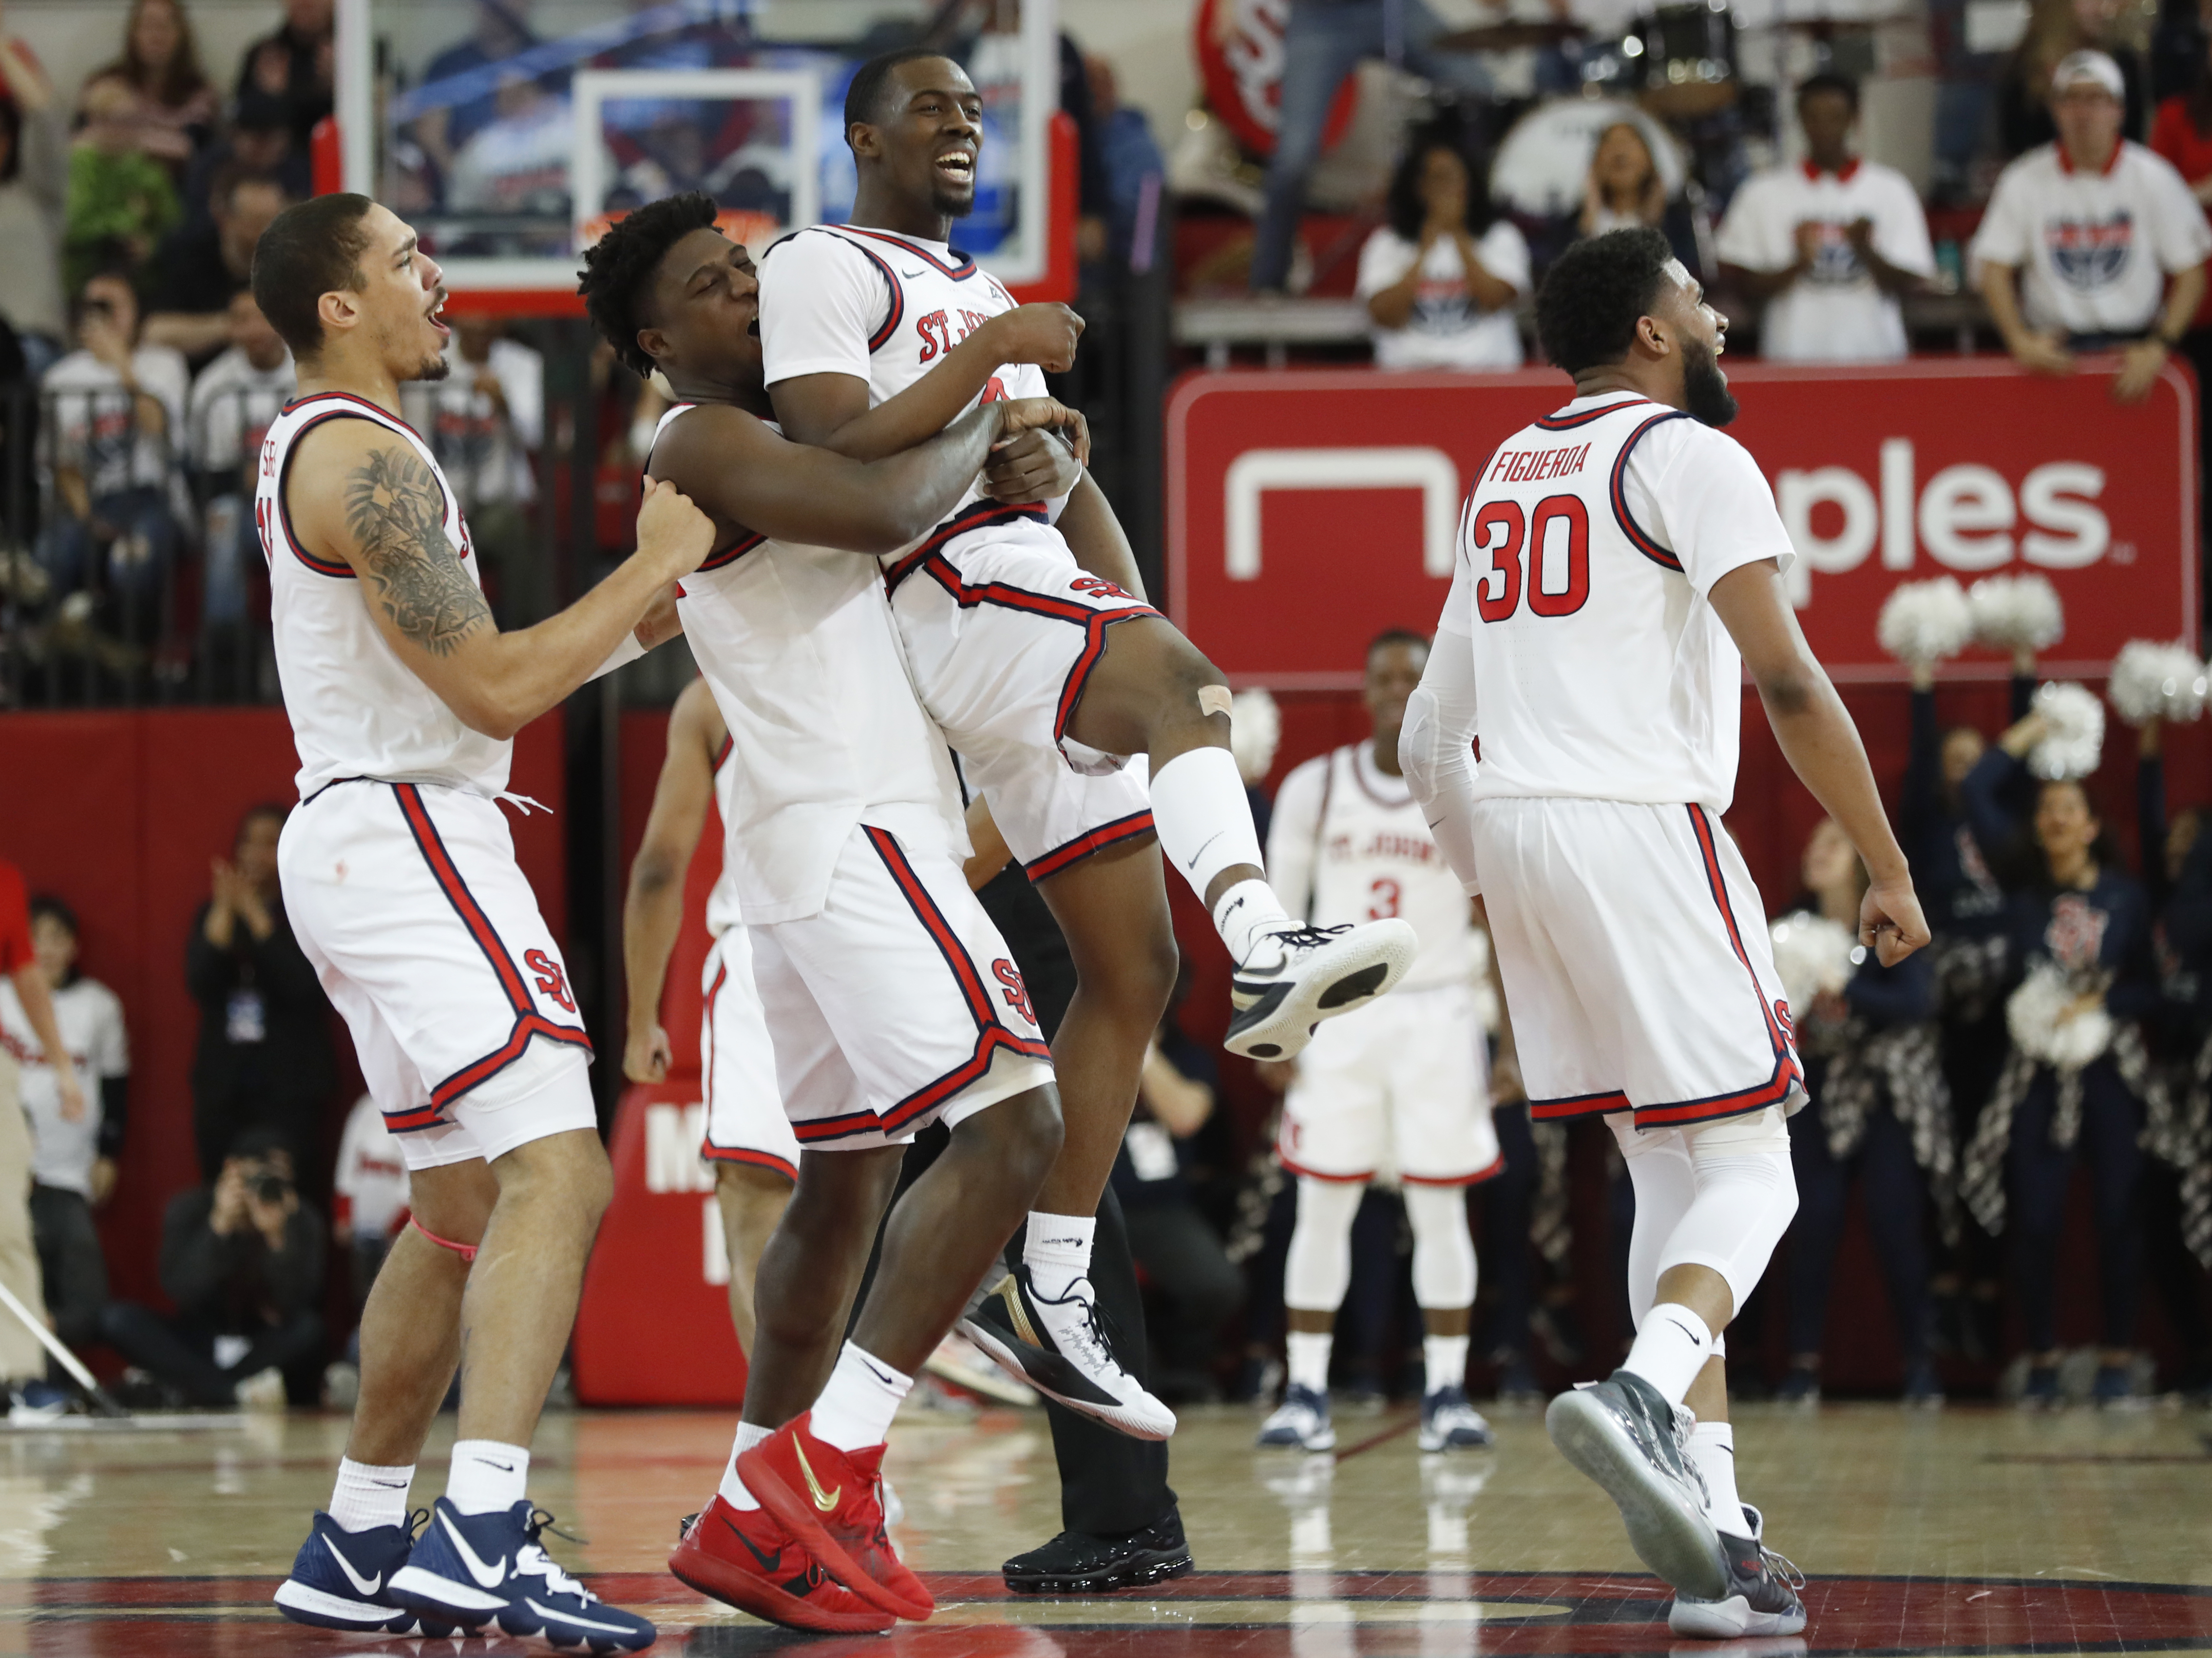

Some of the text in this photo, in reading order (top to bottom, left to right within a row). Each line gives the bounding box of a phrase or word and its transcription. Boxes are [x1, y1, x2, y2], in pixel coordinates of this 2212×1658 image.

[1489, 442, 1592, 482] FIGUEROA
[1474, 494, 1589, 623] 30
[1776, 437, 2110, 610] ples
[1368, 877, 1400, 921] 3
